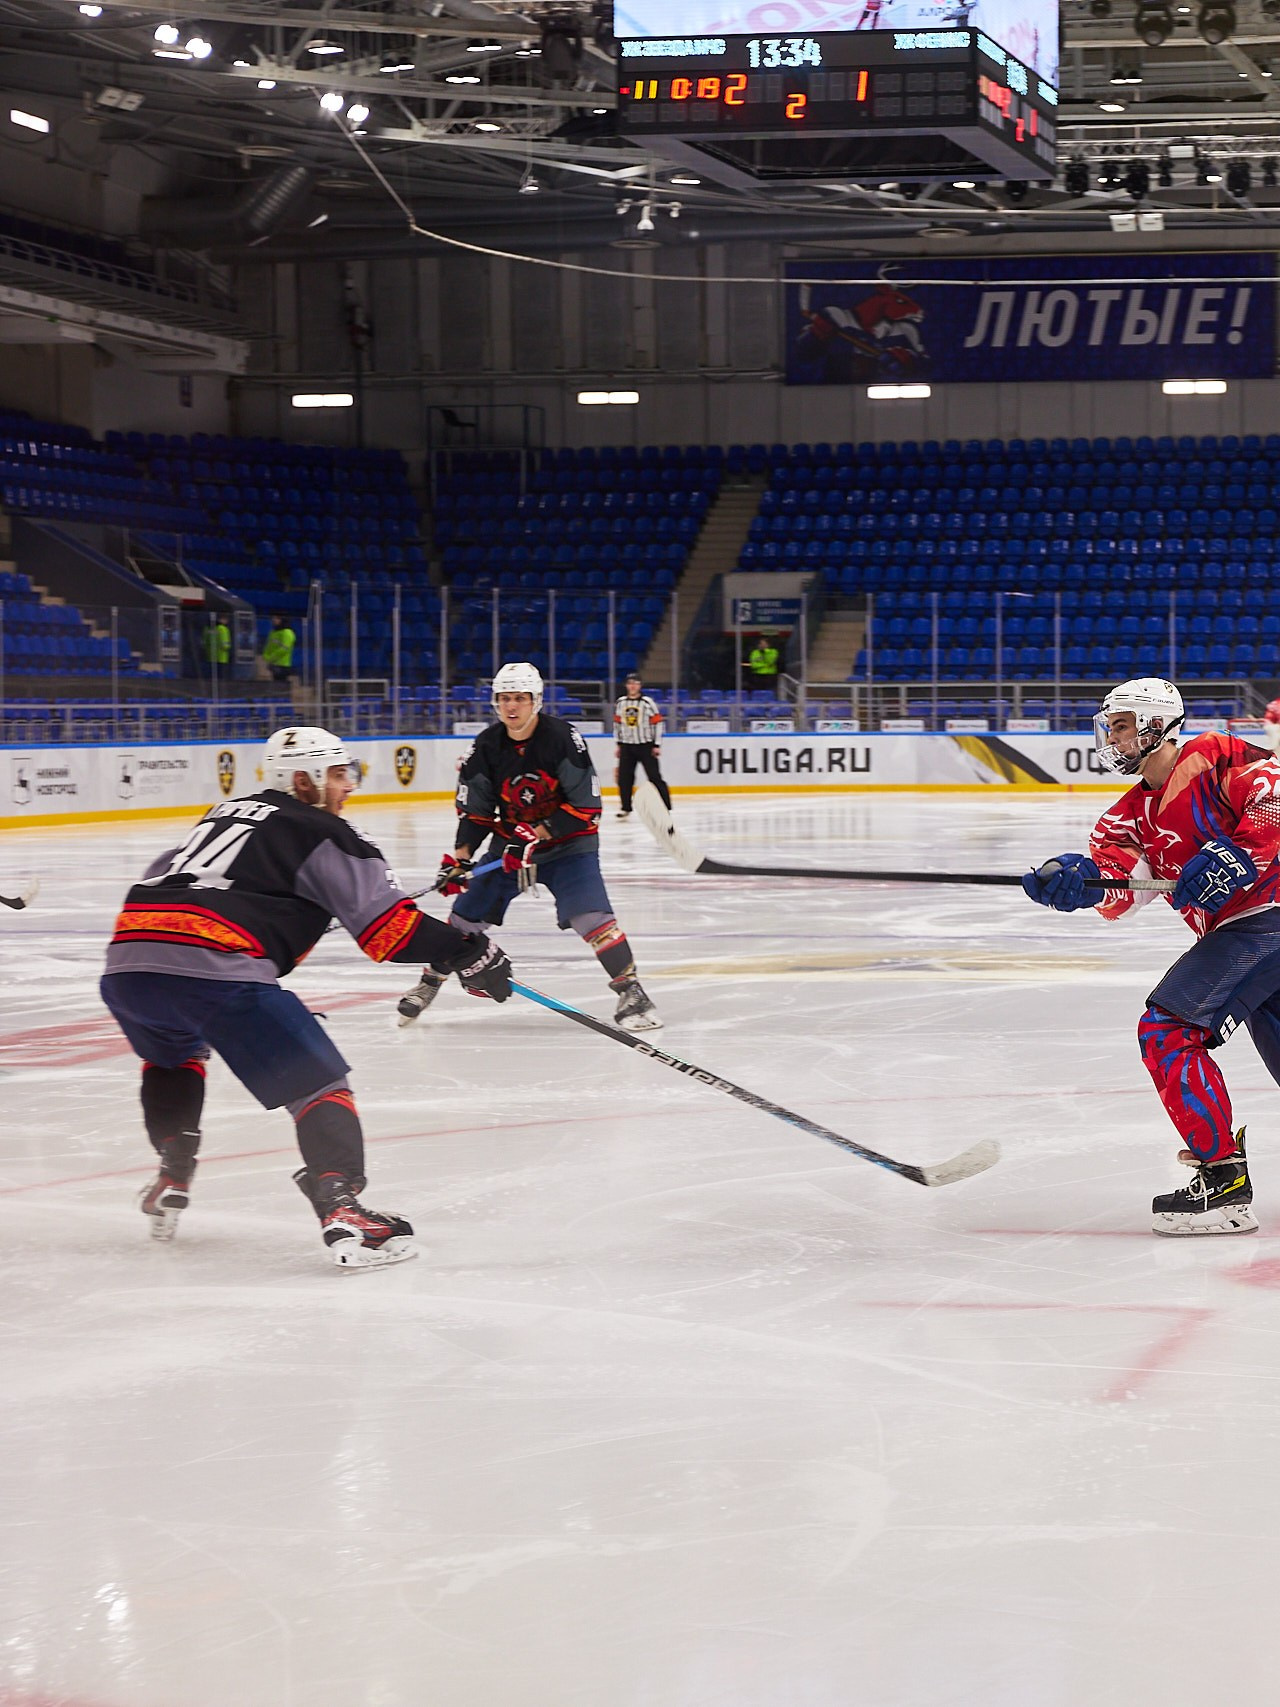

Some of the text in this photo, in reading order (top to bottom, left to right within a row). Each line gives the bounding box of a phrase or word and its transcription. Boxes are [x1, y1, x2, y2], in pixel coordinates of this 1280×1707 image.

[724, 73, 747, 105] 2
[857, 70, 869, 101] 1
[785, 93, 807, 119] 2
[964, 286, 1253, 348] ЛЮТЫЕ!
[695, 747, 871, 774] OHLIGA.RU
